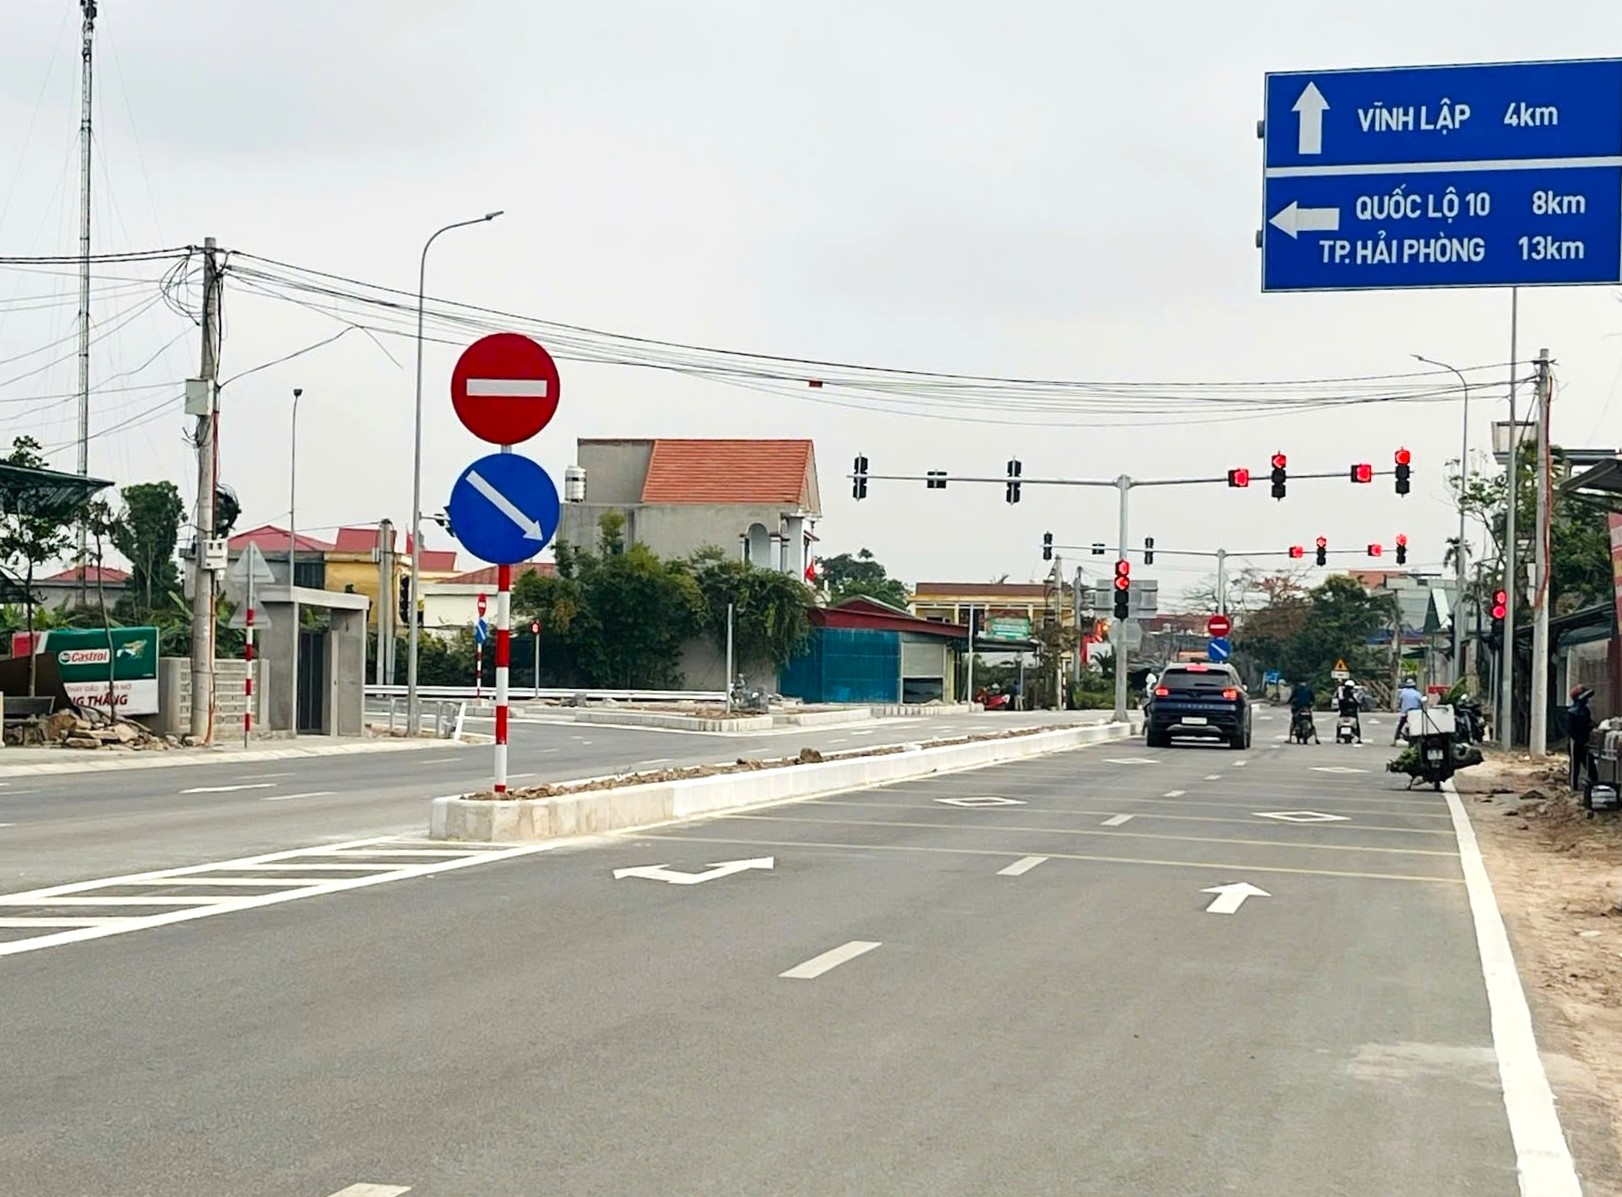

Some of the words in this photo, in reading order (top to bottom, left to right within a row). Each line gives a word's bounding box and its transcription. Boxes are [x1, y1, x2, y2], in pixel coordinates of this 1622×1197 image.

[1357, 101, 1414, 132] VĨNH
[1420, 97, 1471, 135] LẬP
[1503, 102, 1558, 127] 4km
[1356, 184, 1422, 220] QUỐC
[1427, 186, 1459, 223] LỘ
[1465, 192, 1490, 216] 10
[1532, 190, 1586, 215] 8km
[1319, 239, 1351, 264] TP.
[1356, 230, 1398, 265] HẢI
[1403, 231, 1485, 263] PHÒNG
[1518, 235, 1585, 261] 13km
[71, 651, 107, 662] Castrol
